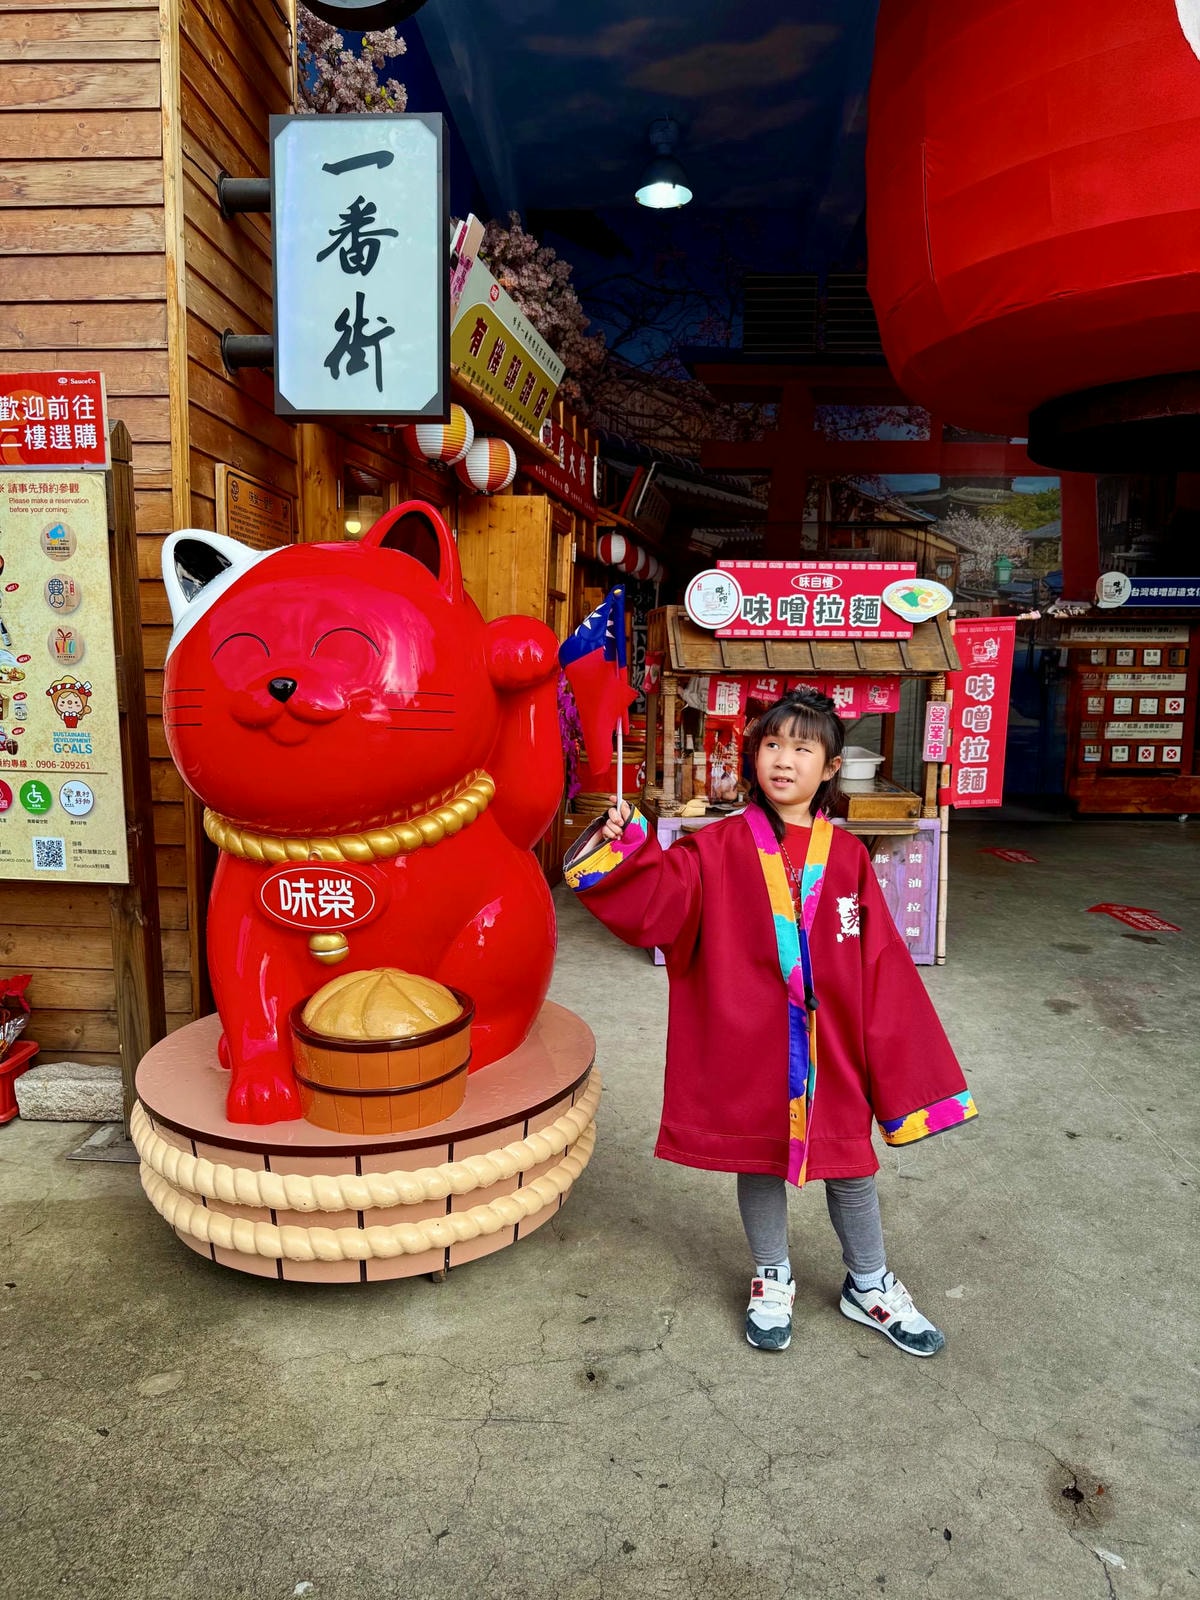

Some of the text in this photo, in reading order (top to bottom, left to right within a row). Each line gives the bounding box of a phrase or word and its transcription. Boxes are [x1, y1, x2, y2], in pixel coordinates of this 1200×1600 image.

[316, 150, 399, 393] 一番街
[0, 395, 96, 421] 歡迎前往
[0, 424, 97, 450] 二樓選購
[798, 576, 834, 589] 味自慢
[742, 595, 881, 627] 味噌拉麵
[927, 706, 946, 758] 營業中
[958, 674, 995, 794] 味噌拉麵
[54, 744, 93, 754] GOALS
[278, 877, 355, 919] 味榮
